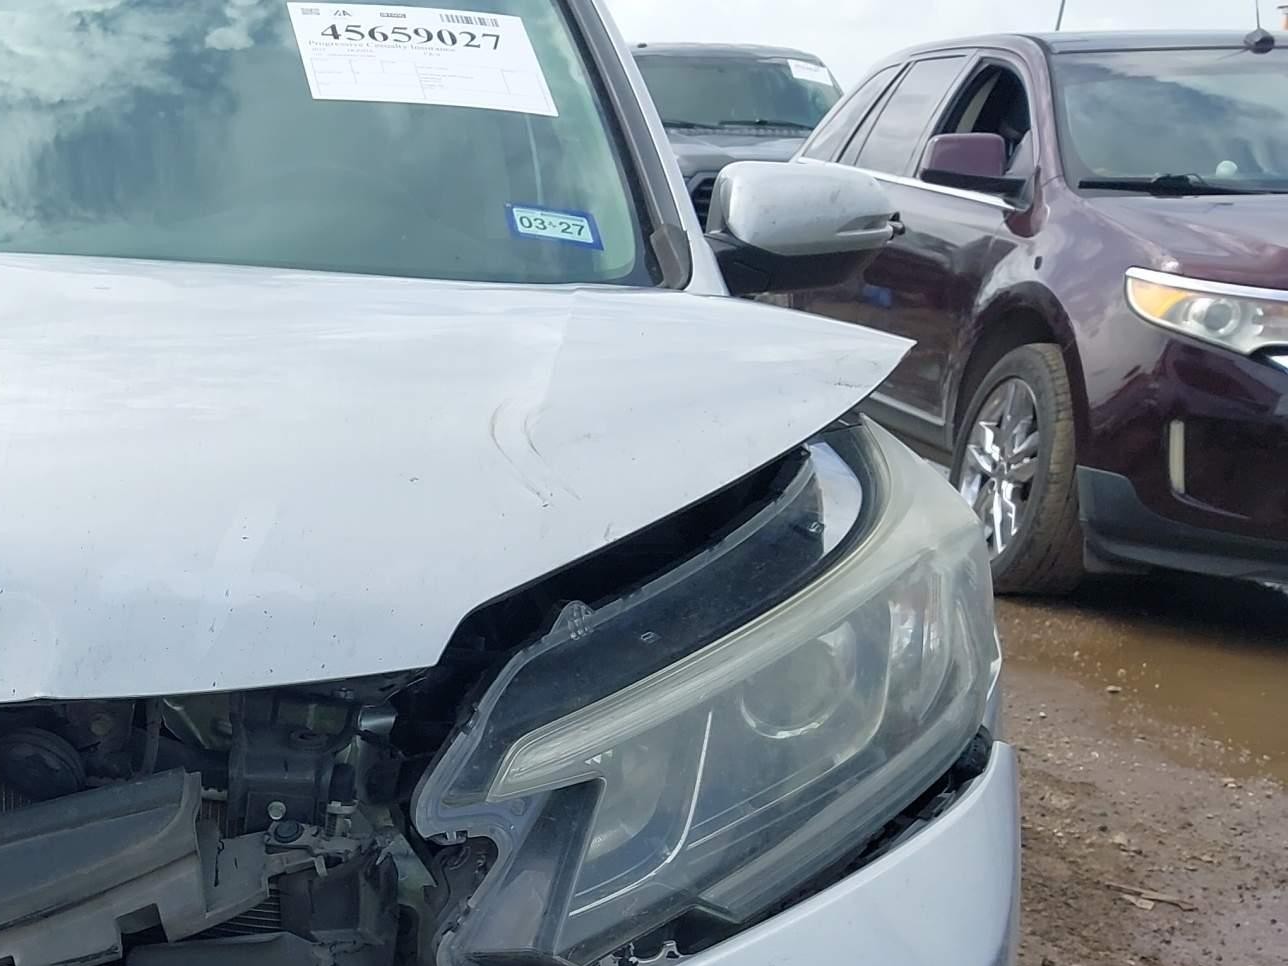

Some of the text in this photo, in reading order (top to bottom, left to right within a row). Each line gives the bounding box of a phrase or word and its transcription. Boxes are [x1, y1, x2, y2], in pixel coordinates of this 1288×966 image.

[320, 23, 500, 50] 45659027
[519, 215, 585, 237] 03 27
